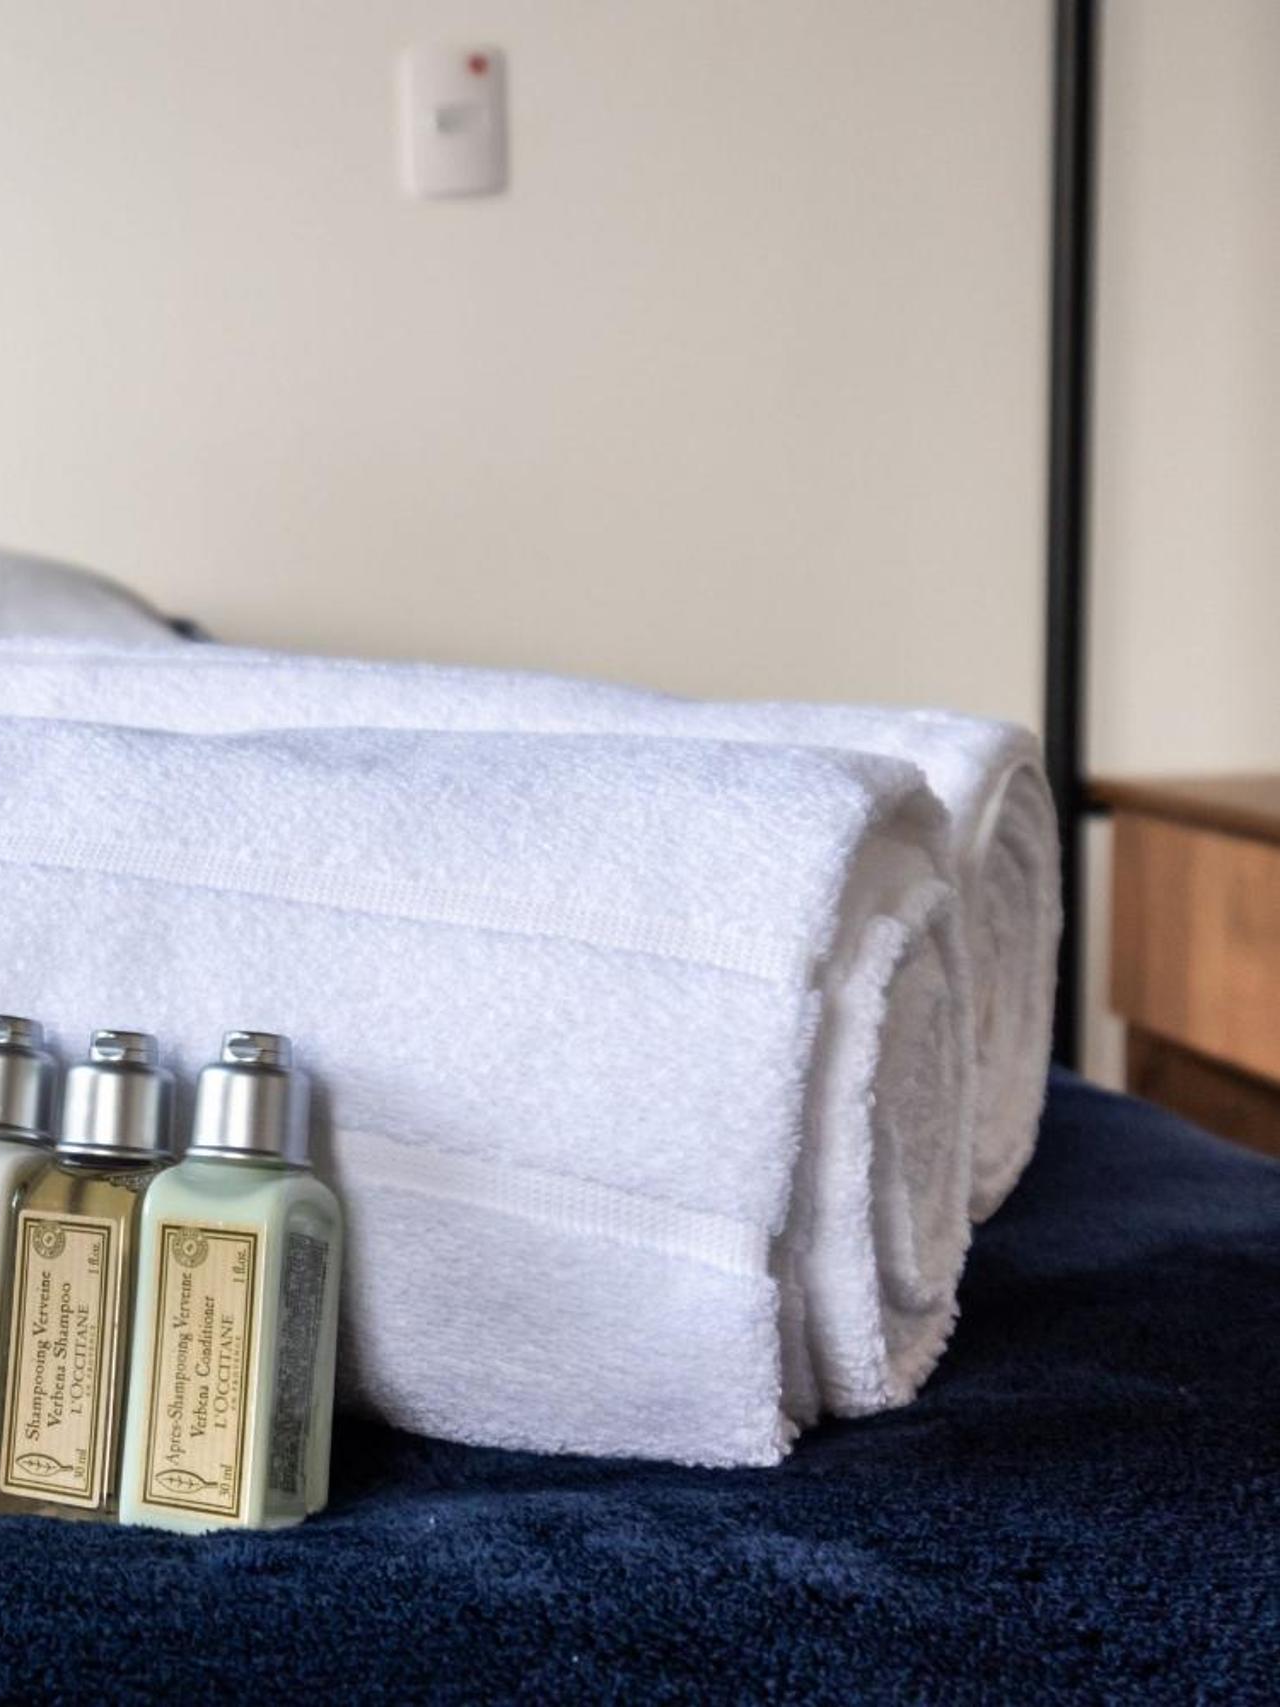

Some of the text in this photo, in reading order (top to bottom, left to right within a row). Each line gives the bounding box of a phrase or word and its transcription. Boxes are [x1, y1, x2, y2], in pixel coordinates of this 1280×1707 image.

[32, 1271, 52, 1337] Verveine
[173, 1272, 193, 1330] Verveine
[25, 1340, 51, 1441] Shampooing
[47, 1282, 75, 1428] Verbena Shampoo
[190, 1296, 216, 1439] Verbena Conditioner
